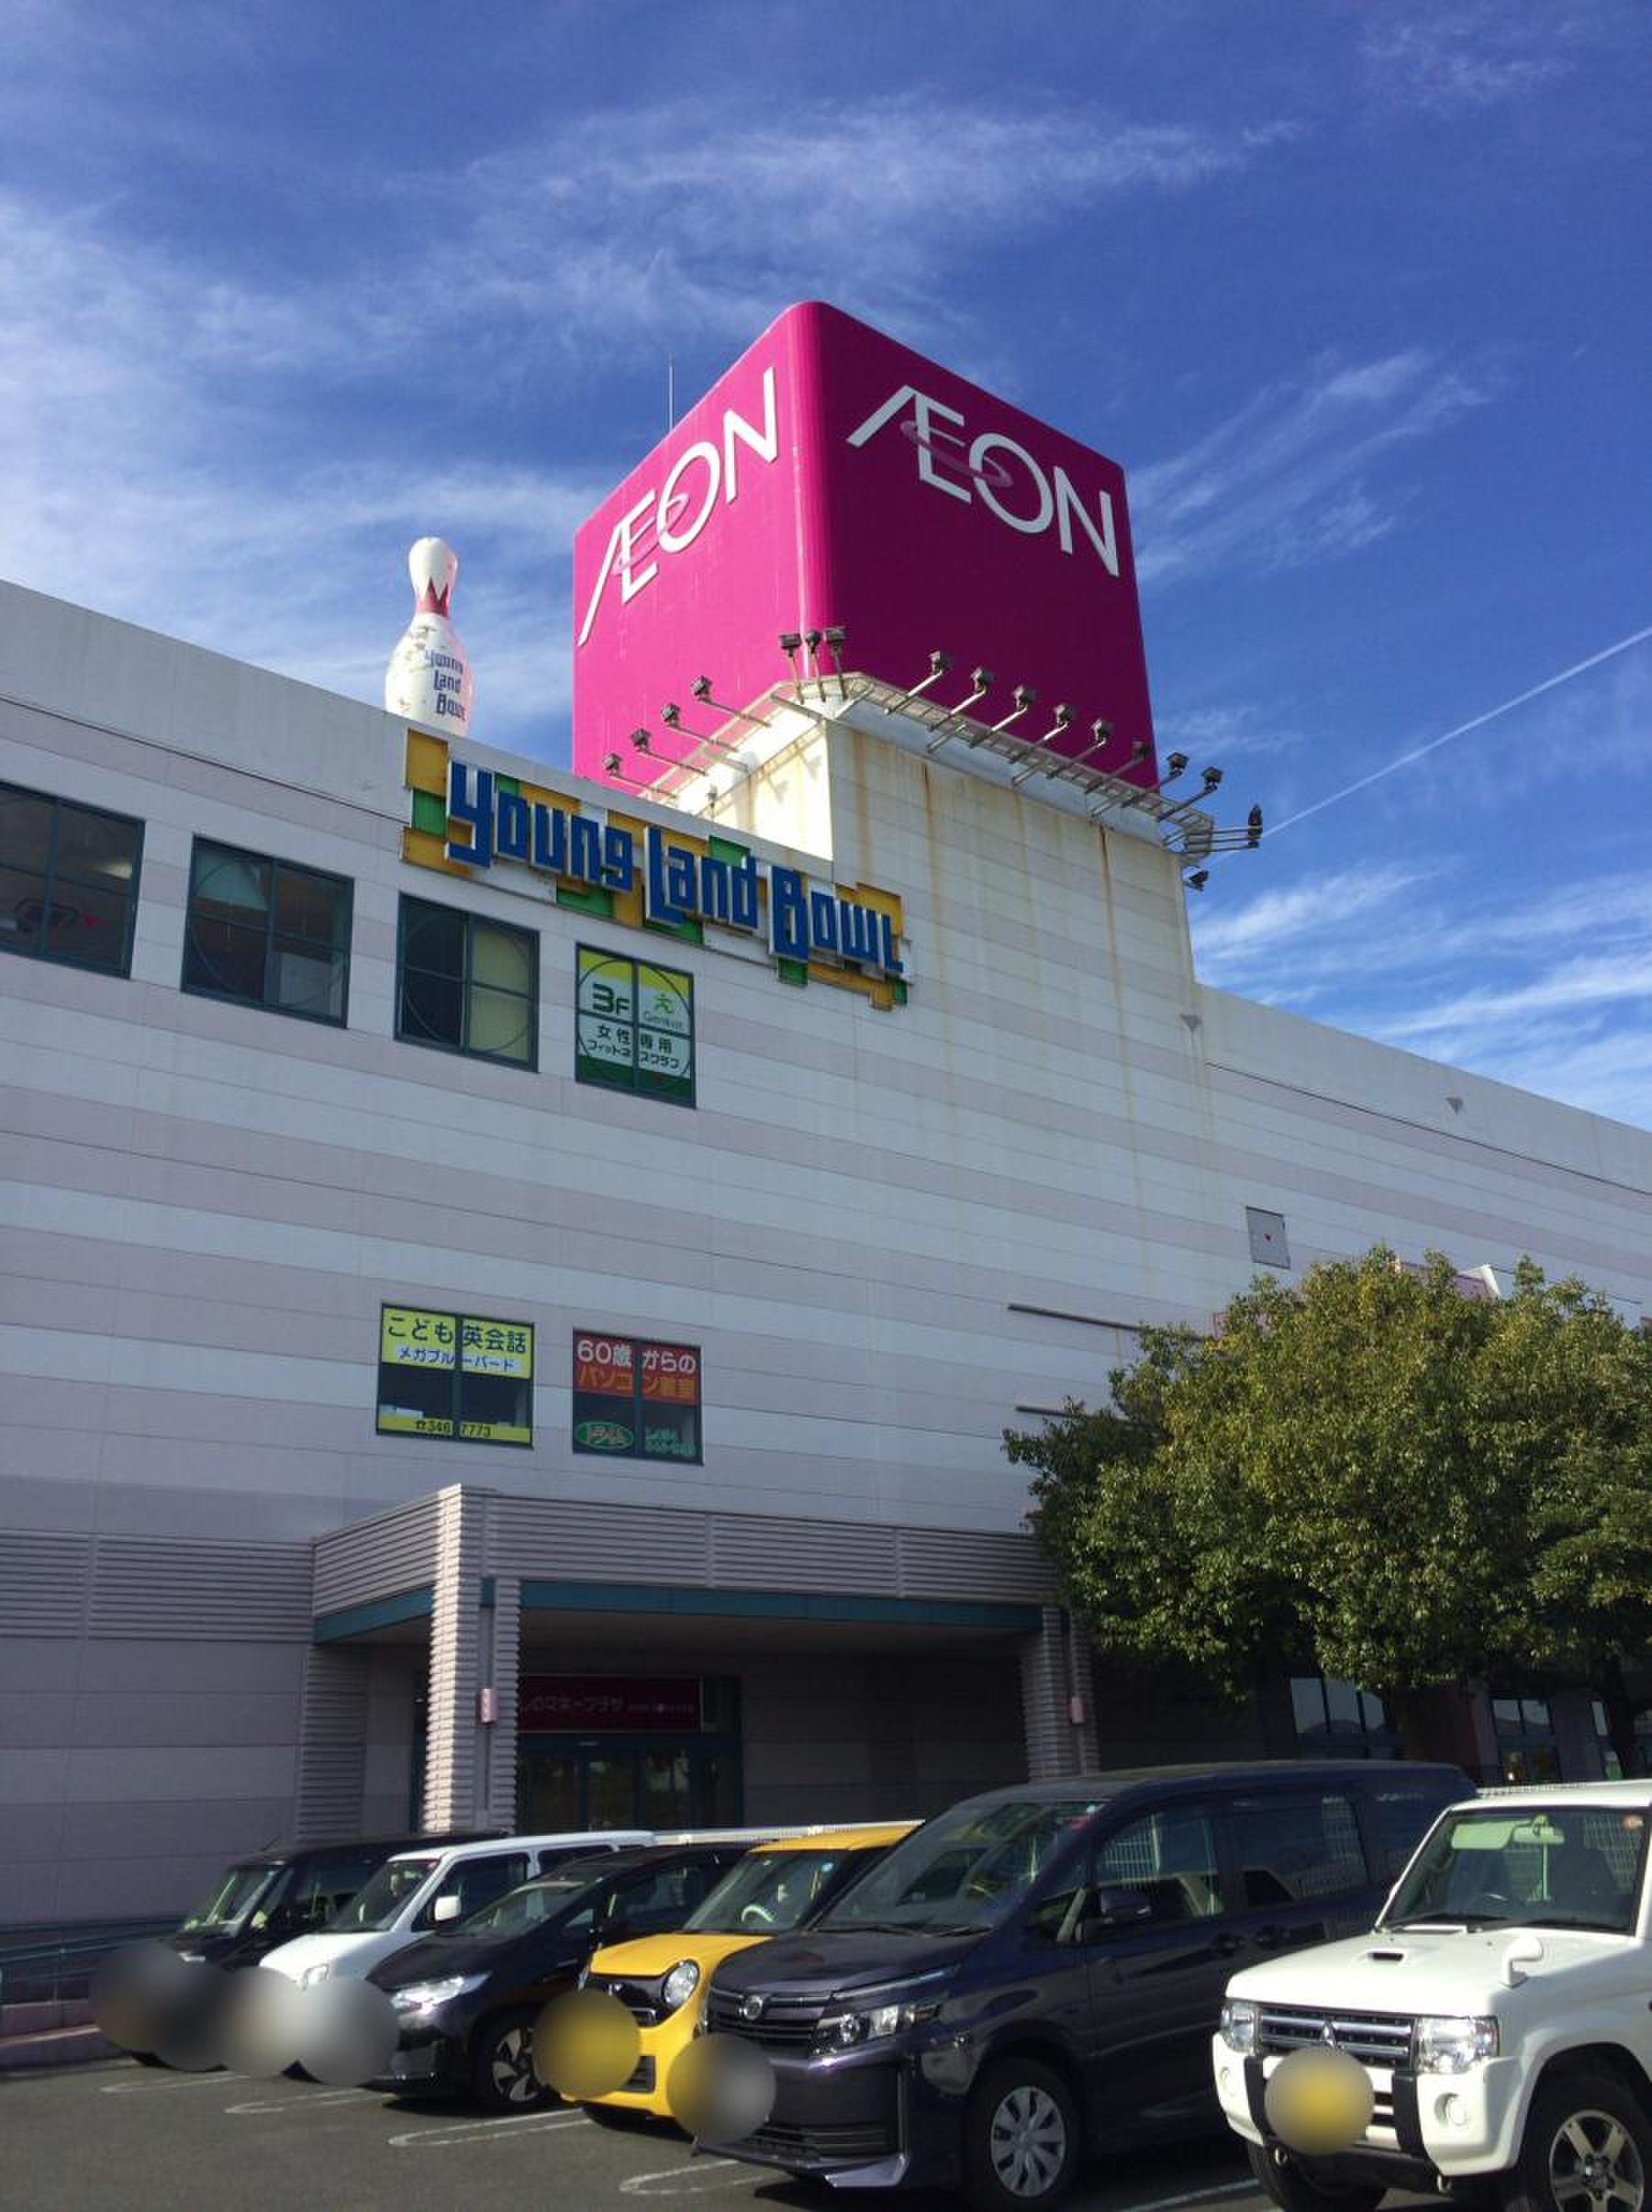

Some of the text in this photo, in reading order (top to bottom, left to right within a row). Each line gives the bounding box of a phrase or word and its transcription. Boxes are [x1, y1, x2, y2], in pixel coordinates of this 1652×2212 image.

[444, 761, 634, 892] Young
[644, 825, 759, 931] Land
[592, 983, 631, 1015] 3F
[388, 1316, 527, 1355] こども英会話
